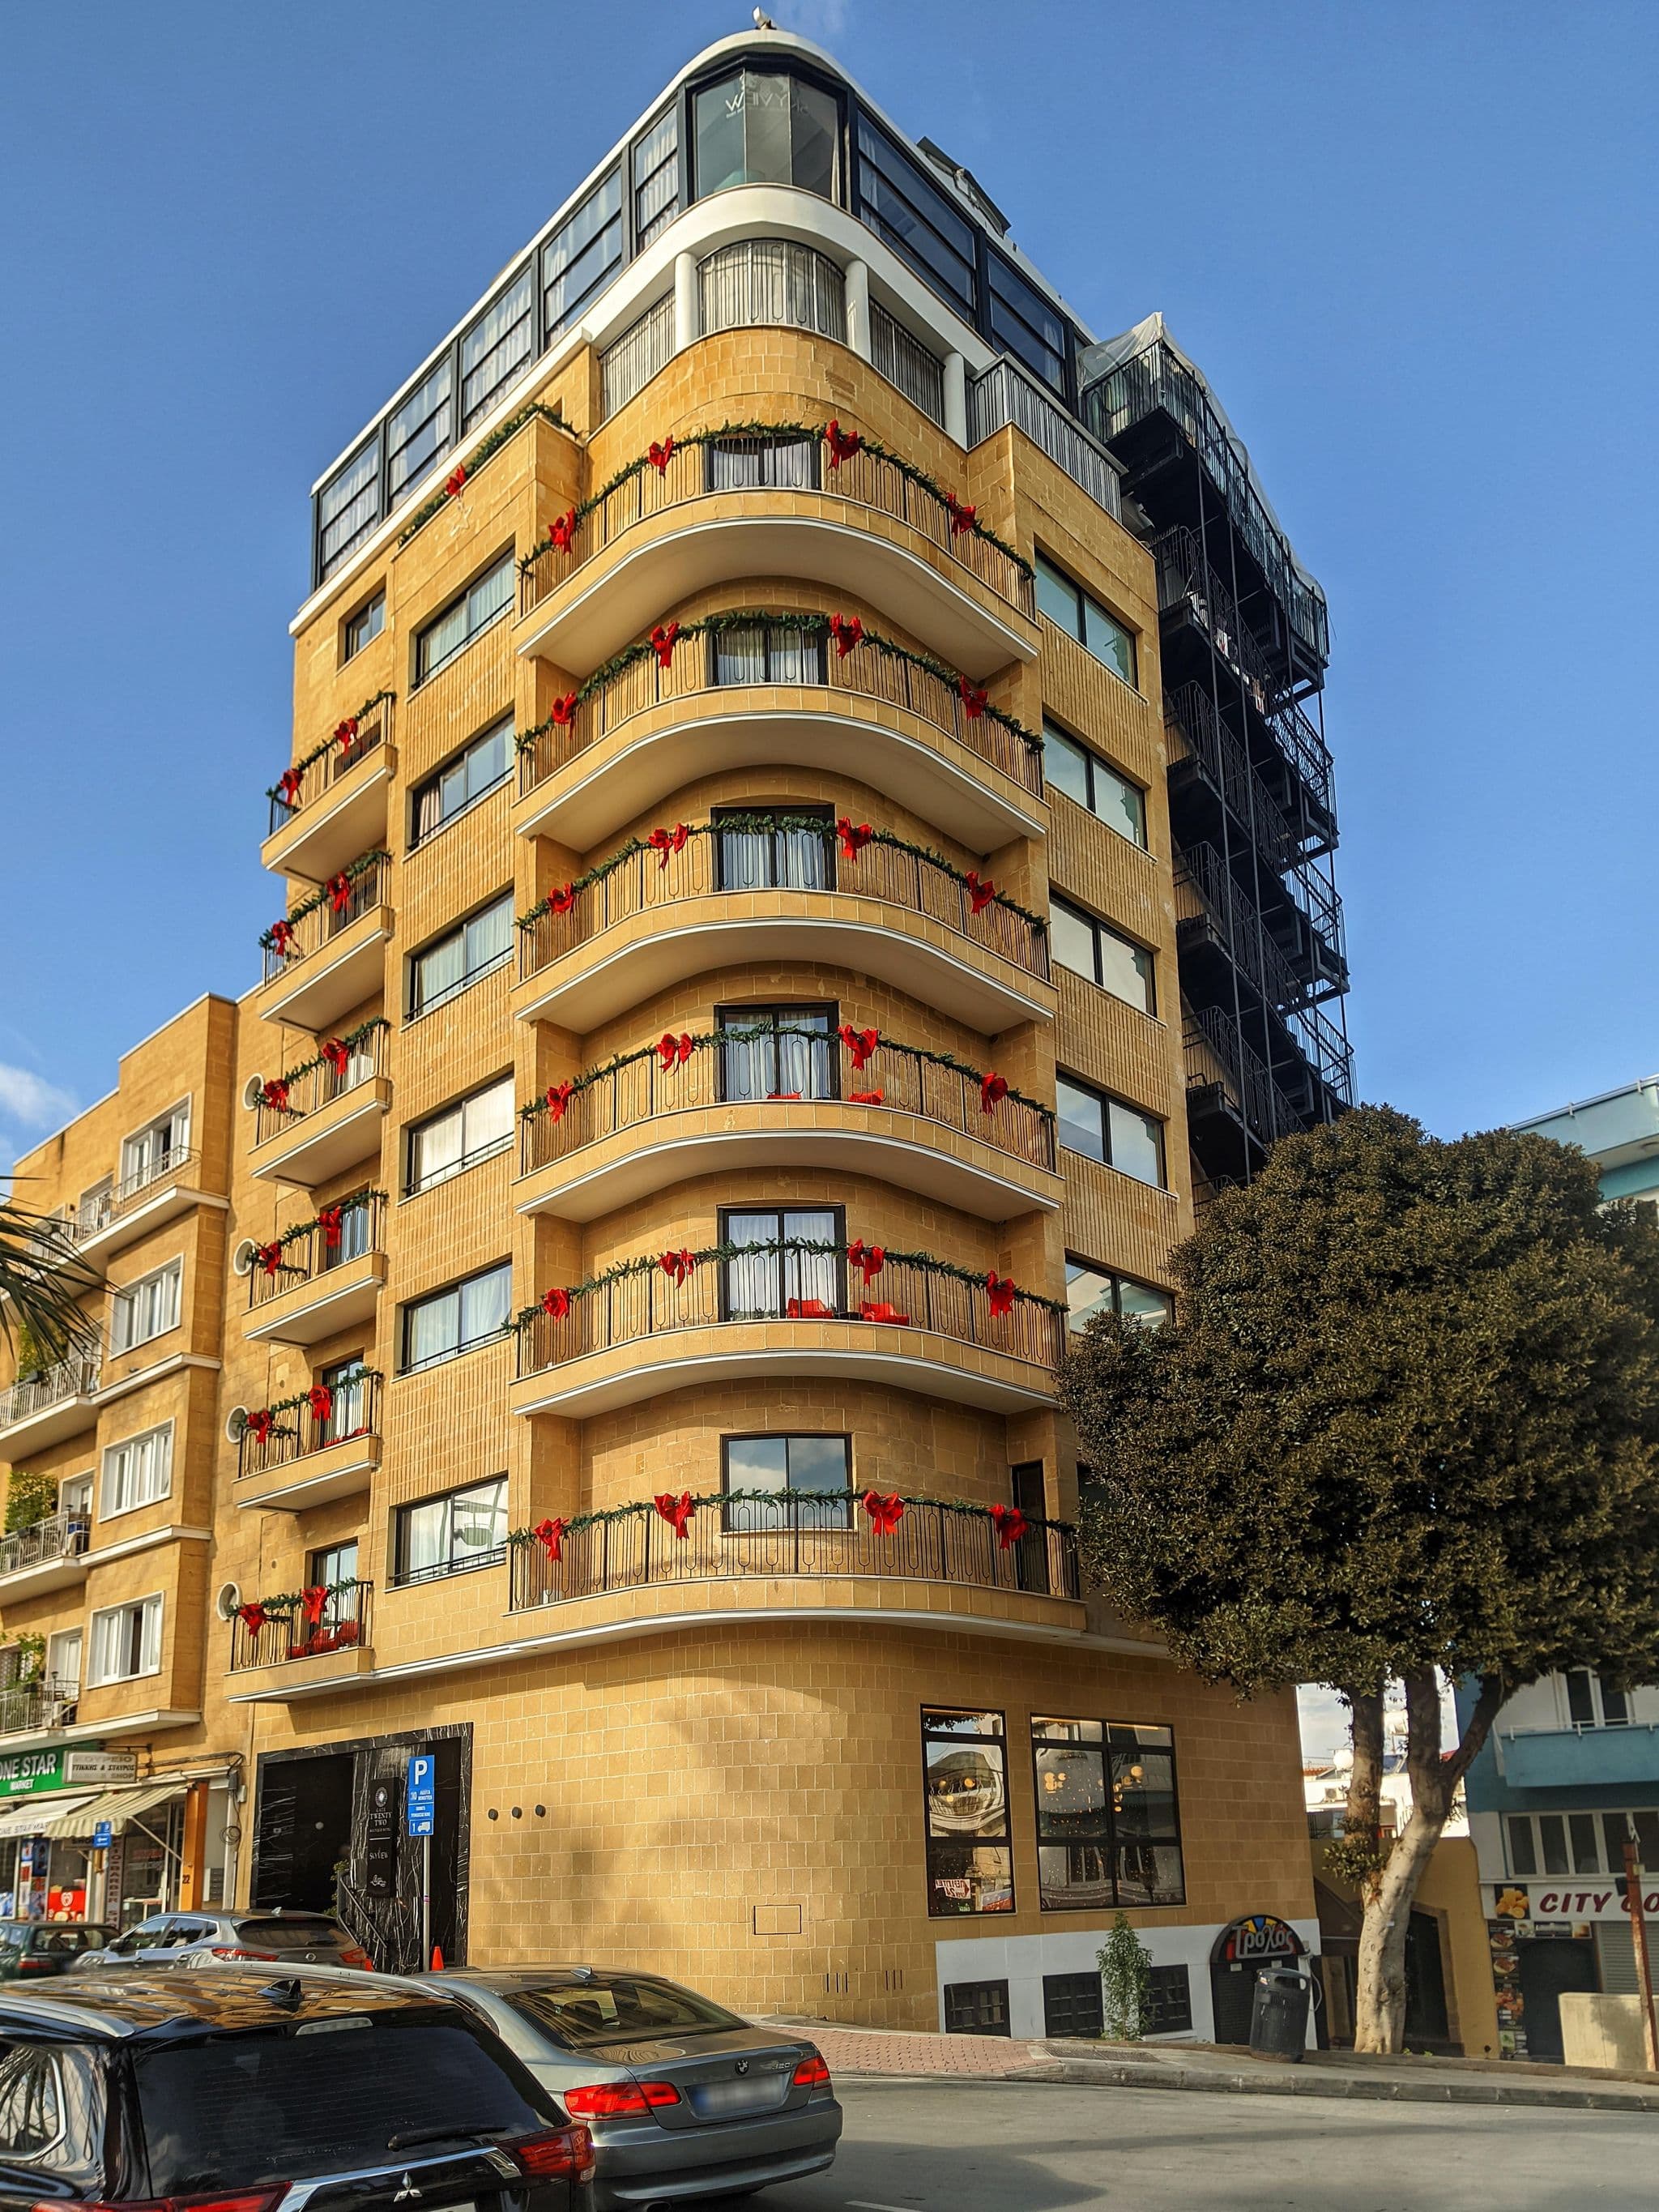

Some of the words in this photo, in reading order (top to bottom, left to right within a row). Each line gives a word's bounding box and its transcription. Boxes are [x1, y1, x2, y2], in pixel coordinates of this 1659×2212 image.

[21, 1753, 57, 1776] STAR
[415, 1760, 428, 1785] P
[412, 1822, 416, 1833] 1
[1539, 1892, 1613, 1913] CITY
